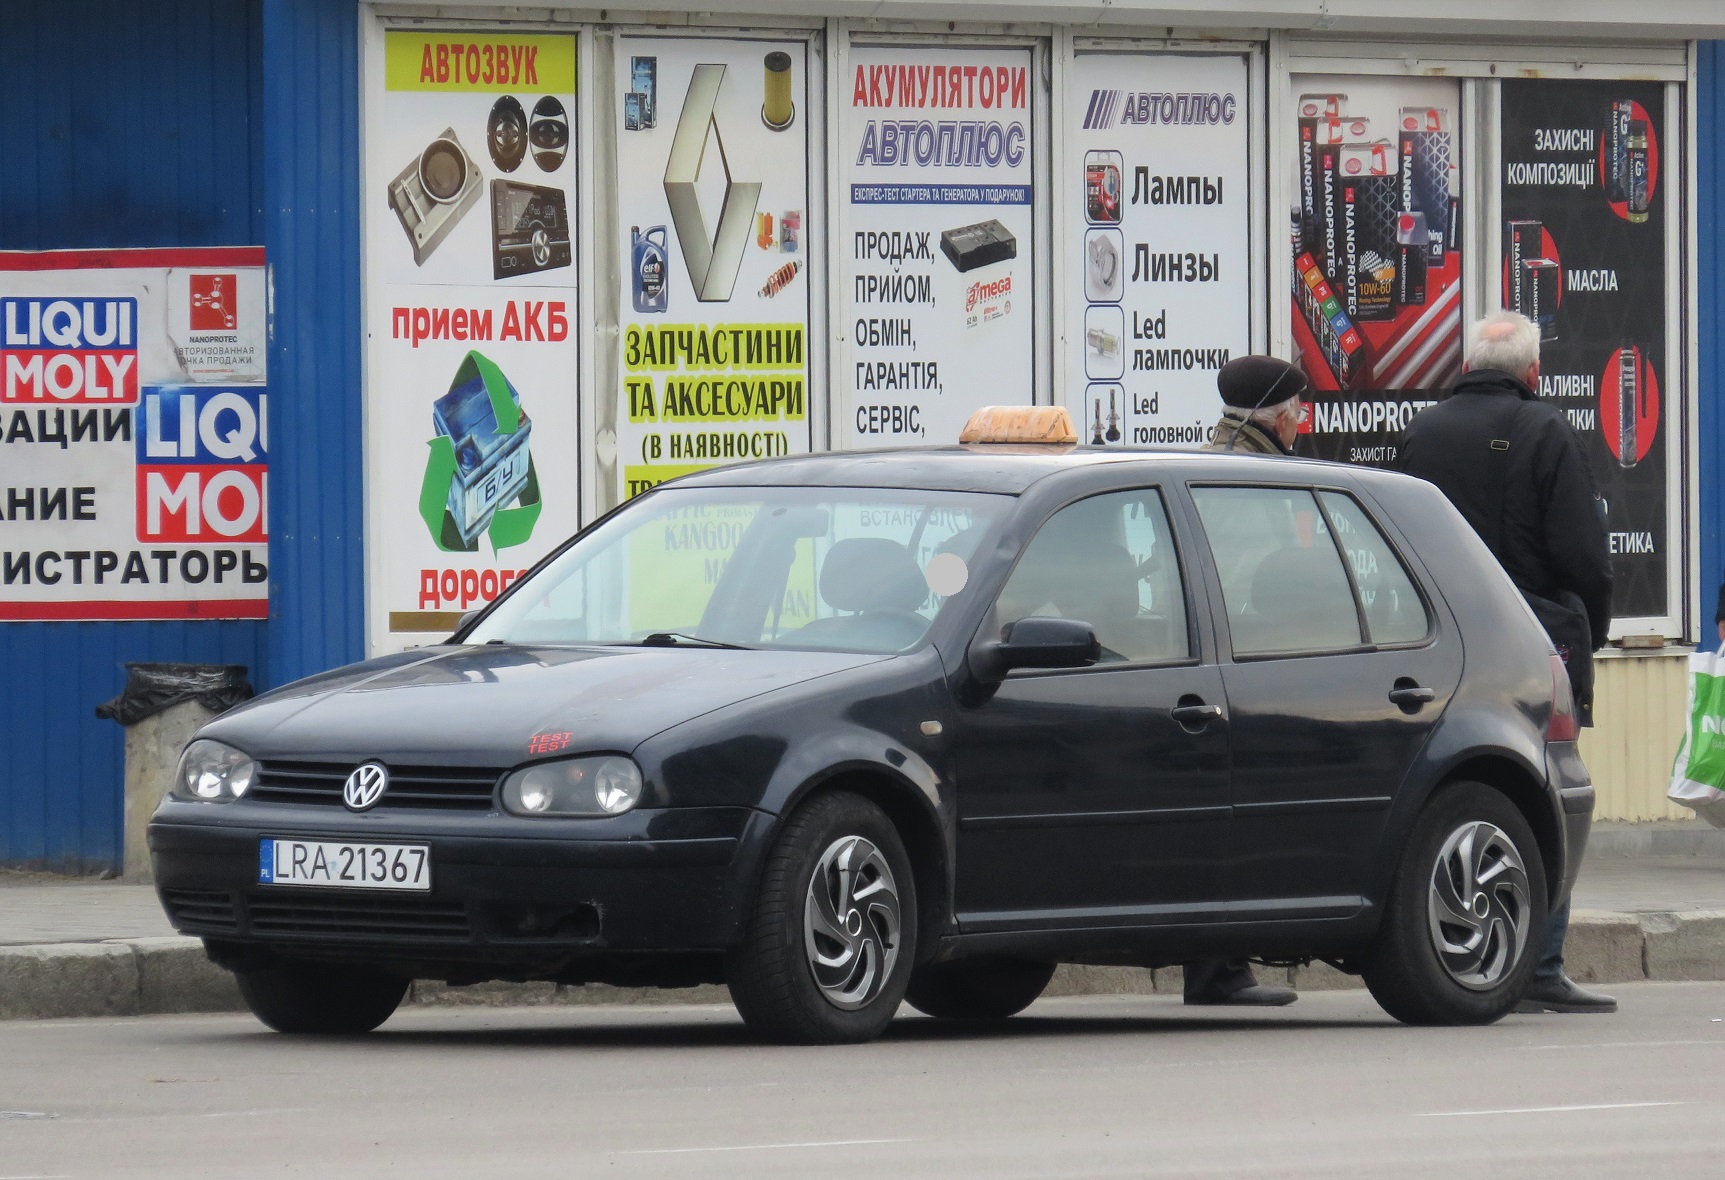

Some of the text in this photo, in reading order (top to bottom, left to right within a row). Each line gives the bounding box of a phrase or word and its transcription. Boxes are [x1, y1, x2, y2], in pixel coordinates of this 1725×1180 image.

[420, 43, 538, 85] АВТОЗВУК
[853, 64, 1026, 108] АКУМУЛЯТОРИ
[1120, 92, 1236, 125] АВТОПЛЮС
[856, 119, 1025, 168] АВТОПЛЮС
[1535, 129, 1594, 151] ЗАХИСНІ
[1132, 165, 1223, 205] Лампы
[1507, 158, 1595, 190] КОМПОЗИЦІЇ
[855, 187, 1025, 203] ЕКСПРЕС-ТЕСТ СТАРТЕРА ТА ГЕНЕРАТОРА У ПОДАРУНОК!
[1324, 170, 1336, 277] NANOPROTEC
[855, 231, 935, 265] ПРОДАЖ,
[1132, 244, 1219, 282] Линзы
[1346, 204, 1357, 315] NANOPROTEC
[855, 267, 936, 308] ПРИЙОМ,
[1359, 282, 1391, 295] 10W-60
[1568, 269, 1619, 292] МАСЛА
[5, 300, 131, 349] LIQUI
[189, 335, 238, 344] NANOPROTEC
[392, 300, 568, 348] прием АКБ
[855, 318, 916, 351] ОБМІН,
[1133, 309, 1166, 340] Led
[173, 346, 255, 356] АВТОРИЗОВАННАЯ
[206, 356, 253, 366] ПРОДАЖИ
[626, 329, 802, 366] ЗАПЧАСТИНИ
[1133, 348, 1229, 371] лампочки
[5, 353, 136, 400] MOLY
[856, 361, 943, 394] ГАРАНТІЯ,
[626, 381, 802, 417] ТА АКСЕСУАРИ
[1133, 392, 1159, 415] Led
[0, 408, 132, 449] АЦИИ
[145, 392, 268, 462] LIQ
[856, 405, 925, 438] СЕРВІС,
[1133, 421, 1203, 443] головной
[642, 433, 788, 464] (В НАЯВНОСТІ)
[1350, 446, 1385, 462] ЗАХИСТ
[484, 460, 514, 504] Б/У
[0, 487, 97, 521] НИЕ
[419, 568, 529, 610] дорог
[528, 739, 571, 754] TEST
[531, 731, 573, 744] TEST
[274, 843, 427, 884] LRA 21367
